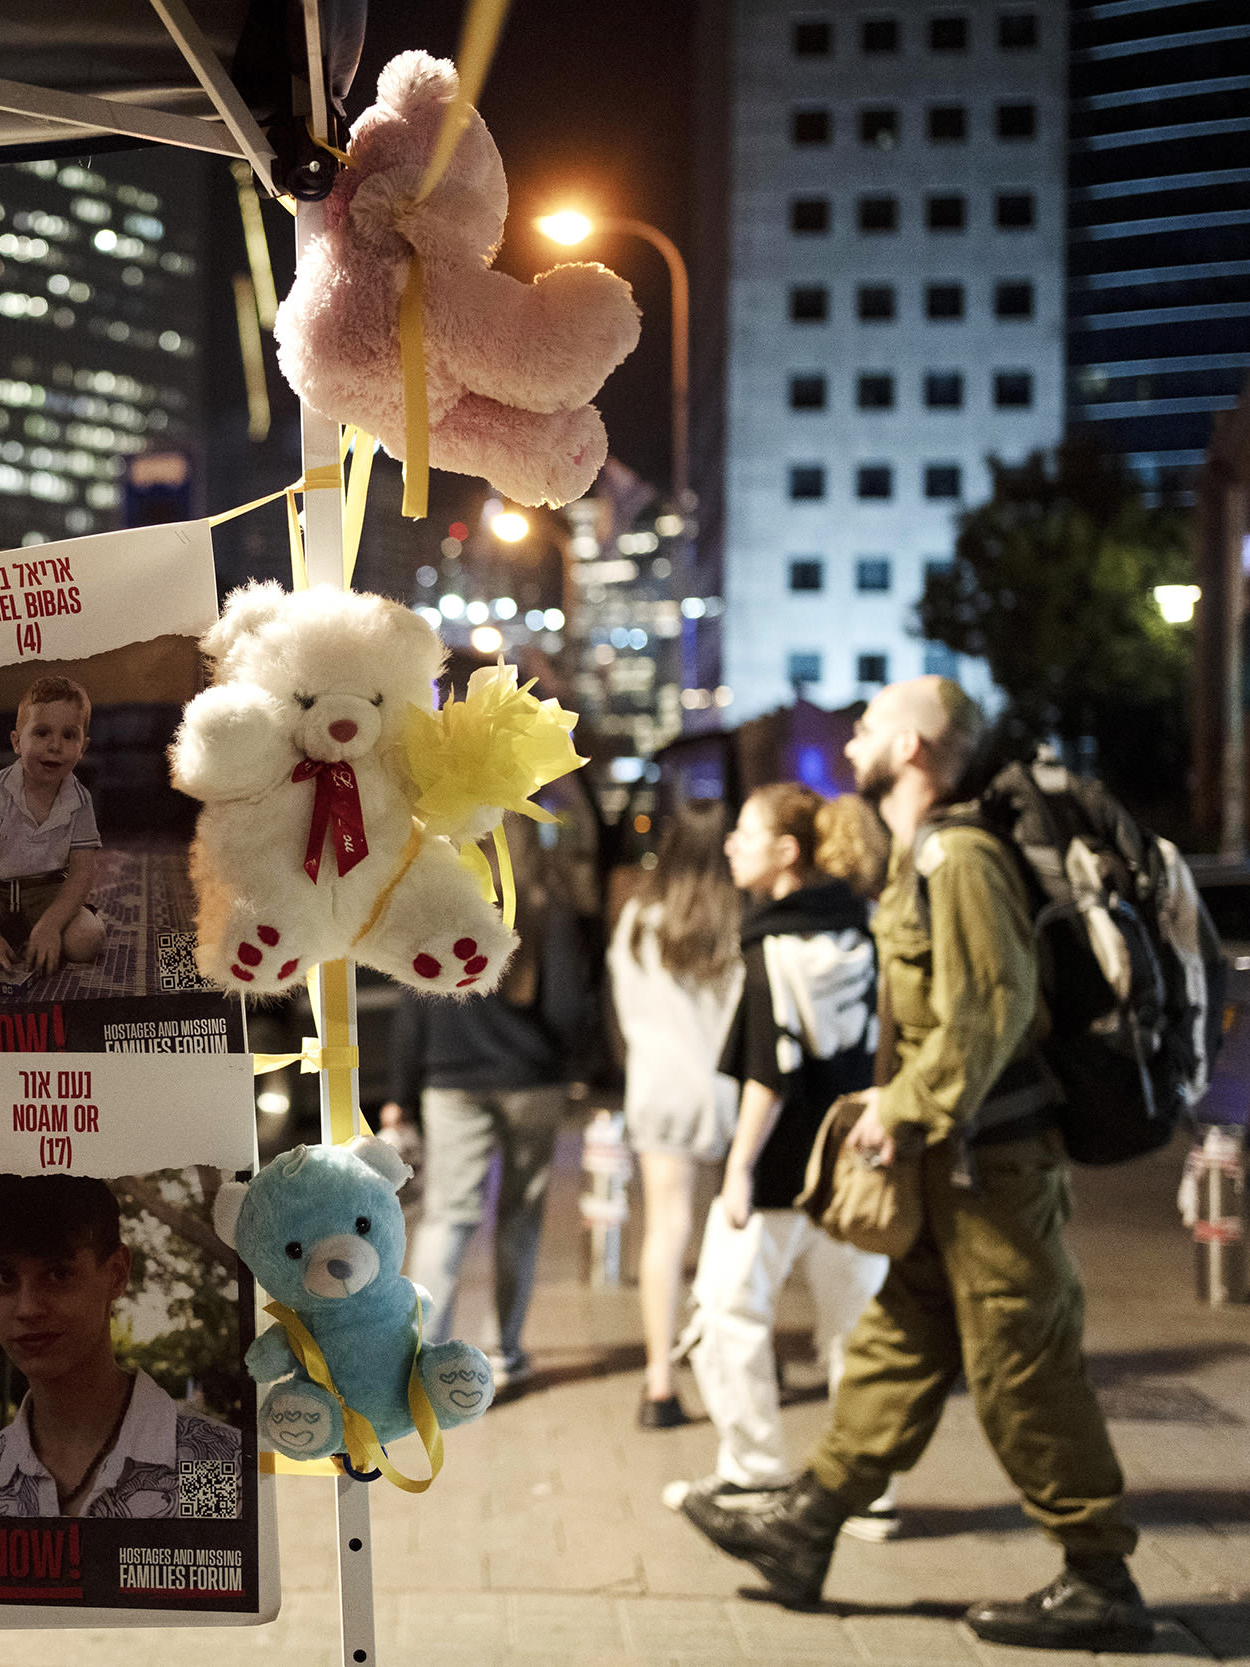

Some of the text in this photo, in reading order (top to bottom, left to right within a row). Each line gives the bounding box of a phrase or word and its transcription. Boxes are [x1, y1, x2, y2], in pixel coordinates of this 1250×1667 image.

[12, 557, 74, 588] אריאל
[24, 586, 82, 619] BIBAS
[16, 621, 42, 656] (4)
[103, 1018, 227, 1040] HOSTAGES AND MISSING
[19, 1071, 91, 1098] נעם אור
[13, 1104, 99, 1133] NOAM OR
[40, 1135, 72, 1169] (17)
[119, 1547, 242, 1567] HOSTAGES AND MISSING
[119, 1565, 243, 1592] FAMILIES FORUM
